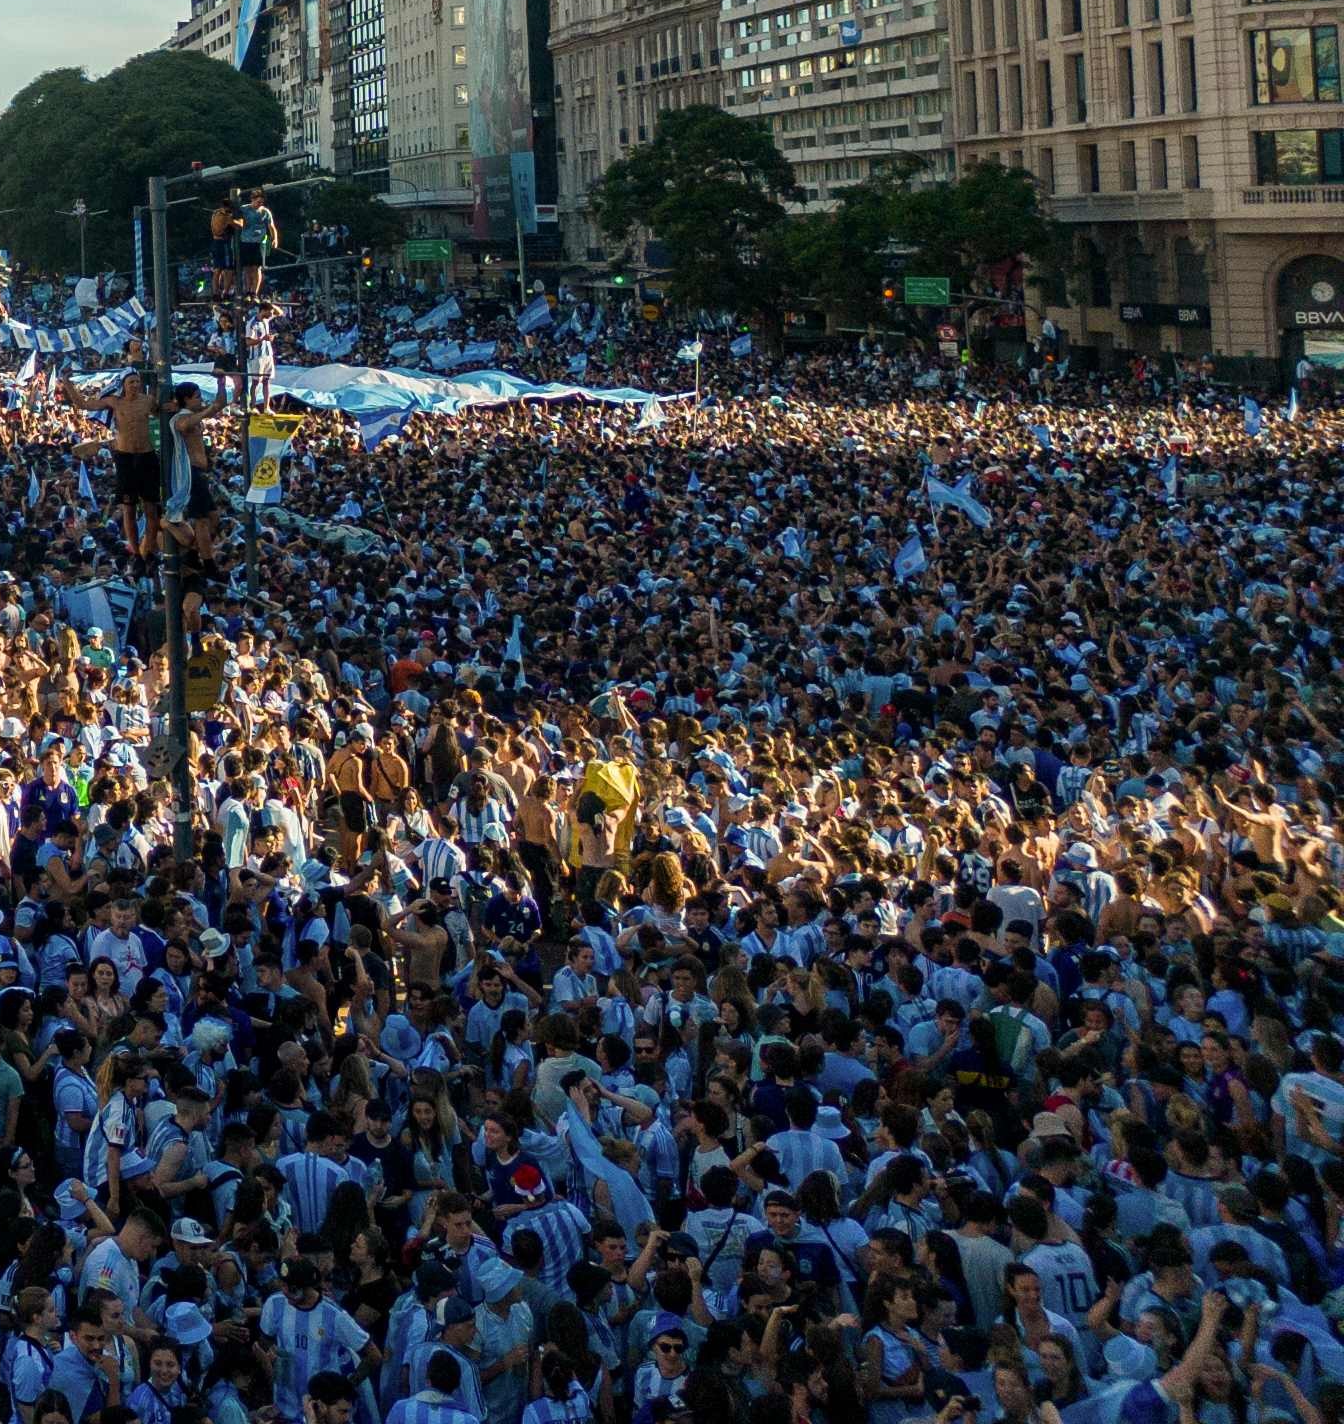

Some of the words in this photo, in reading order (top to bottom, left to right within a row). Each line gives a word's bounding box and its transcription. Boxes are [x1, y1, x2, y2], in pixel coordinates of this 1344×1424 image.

[1178, 309, 1199, 321] BBVA
[1295, 311, 1344, 324] BBVA
[1054, 1271, 1091, 1313] 10
